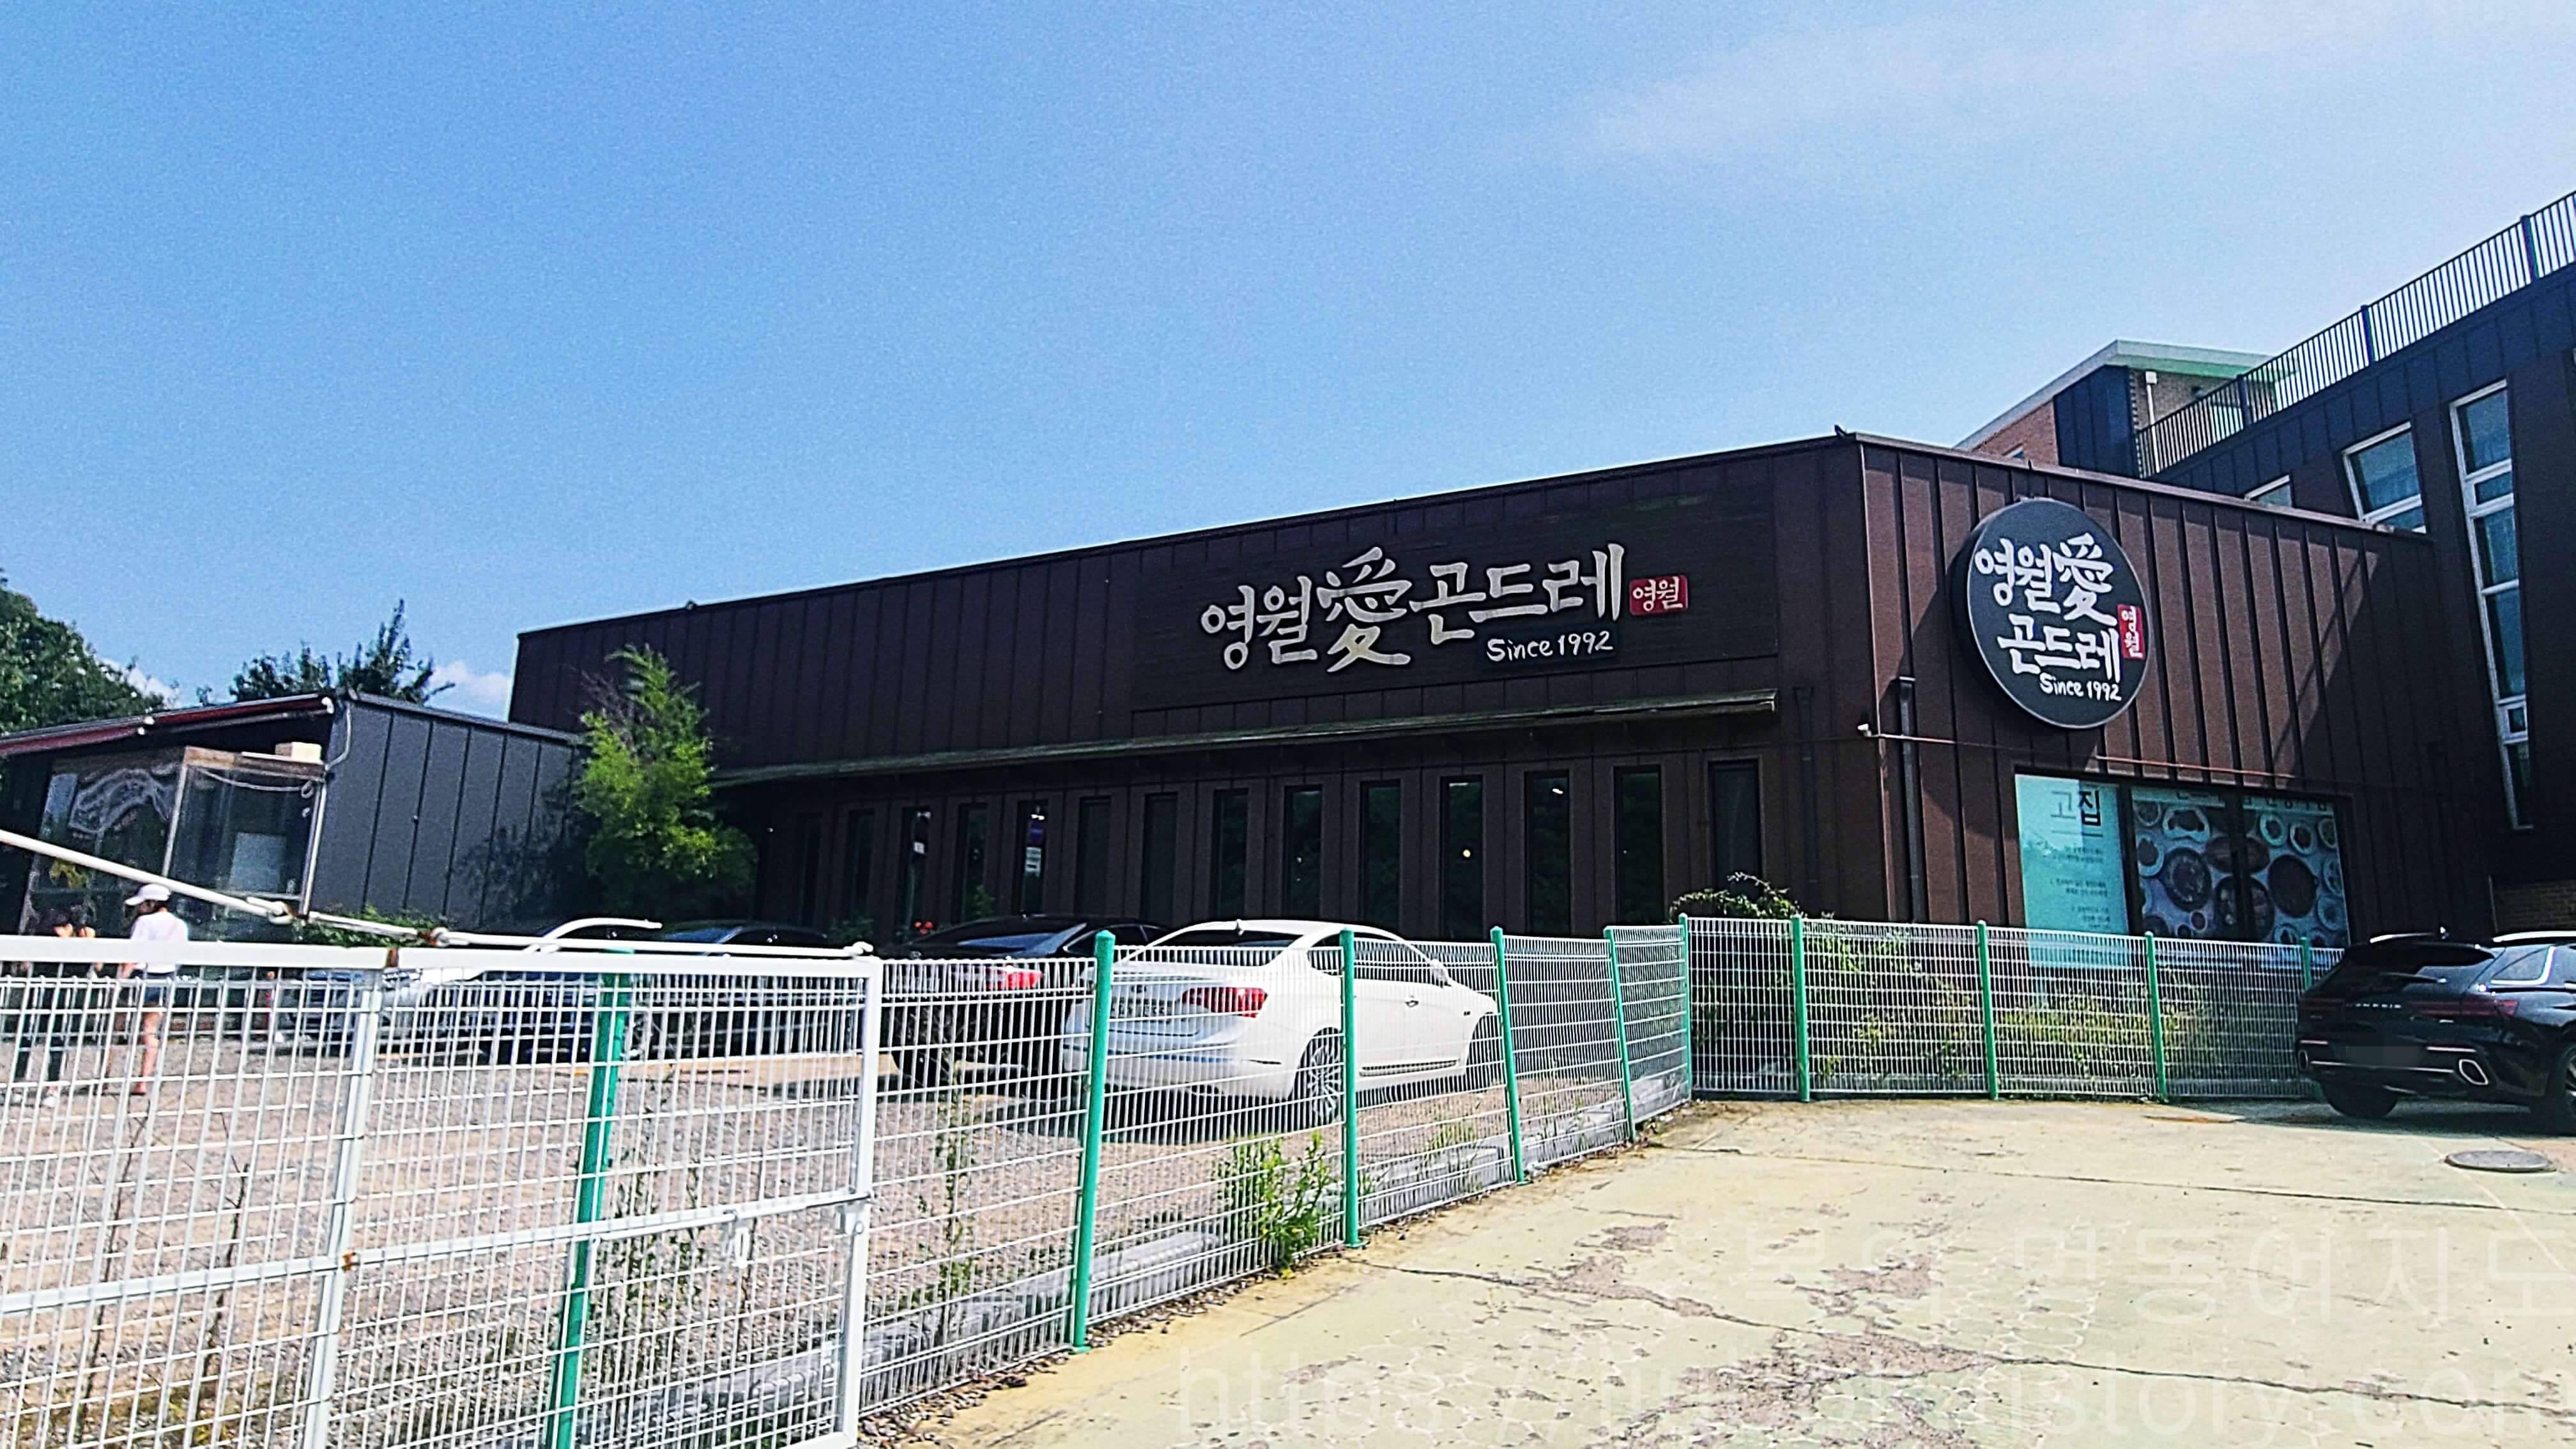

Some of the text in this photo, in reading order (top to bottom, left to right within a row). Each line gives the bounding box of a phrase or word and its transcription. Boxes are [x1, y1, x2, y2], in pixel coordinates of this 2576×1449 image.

[1631, 578, 1682, 612] 영월
[1486, 630, 1614, 662] Since 1992
[1997, 613, 2120, 684] 곤드레
[2121, 605, 2143, 658] 영월
[2039, 672, 2122, 702] Since 1992
